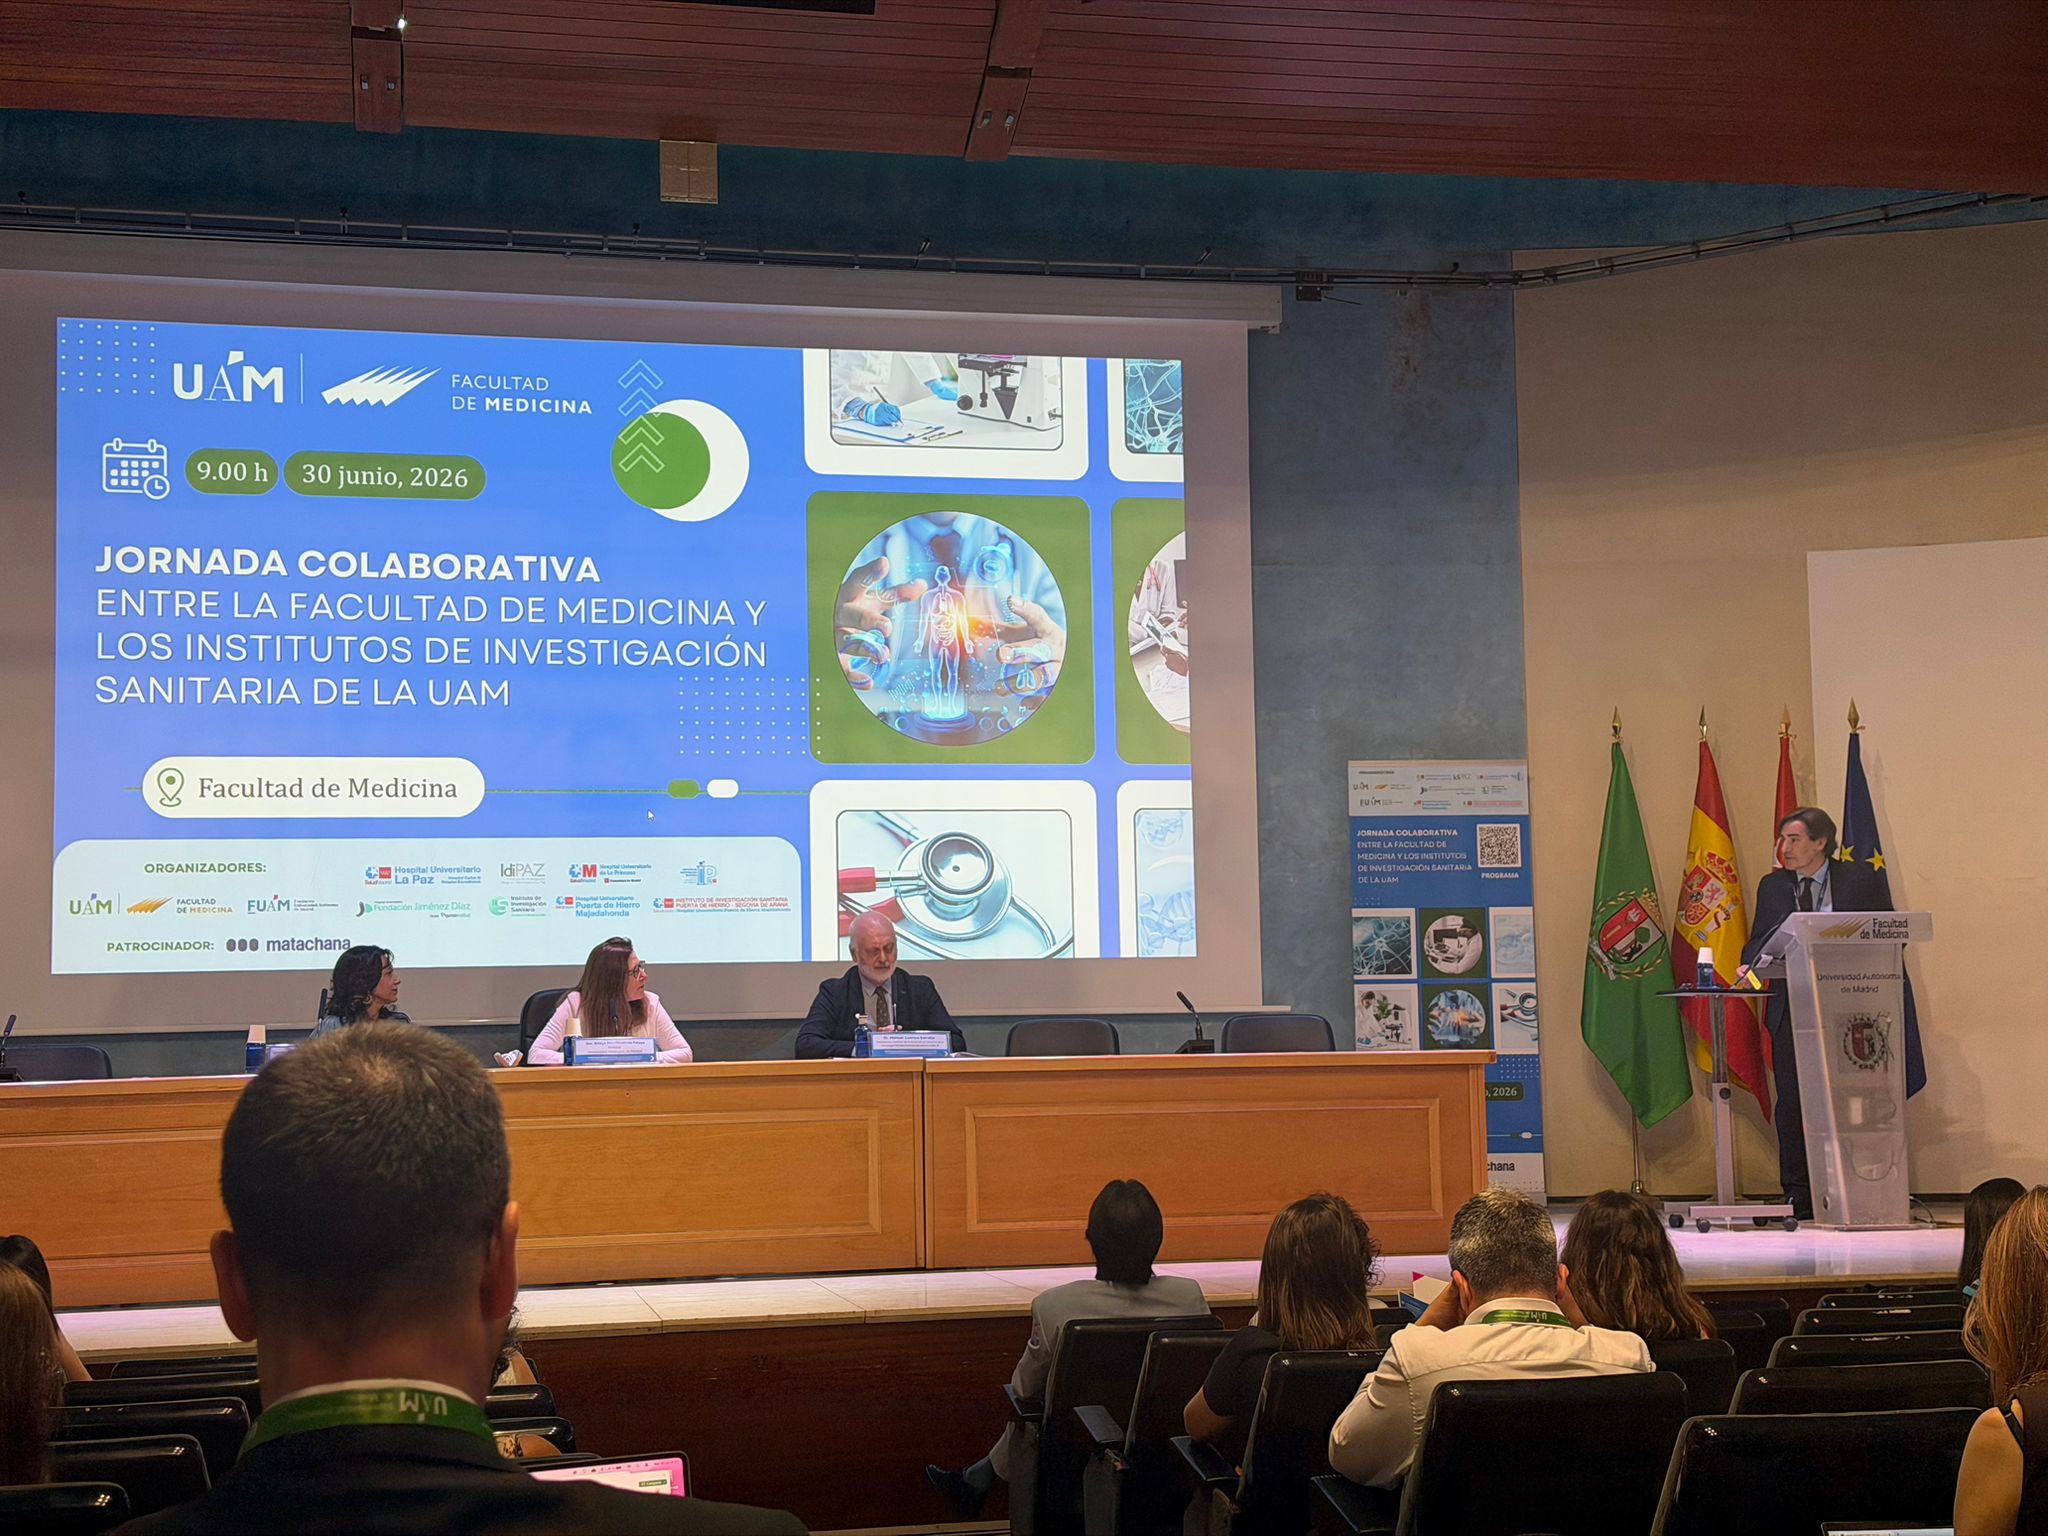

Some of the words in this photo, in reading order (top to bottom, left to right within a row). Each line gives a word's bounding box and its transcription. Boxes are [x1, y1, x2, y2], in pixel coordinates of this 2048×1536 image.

[451, 373, 549, 392] FACULTAD
[451, 395, 477, 412] DE
[484, 397, 593, 415] MEDICINA
[196, 460, 247, 483] 9.00
[253, 462, 269, 483] h
[301, 464, 332, 485] 30
[337, 465, 403, 490] junio,
[409, 467, 468, 488] 2026
[95, 545, 288, 577] JORNADA
[298, 550, 601, 583] COLABORATIVA
[96, 588, 221, 619] ENTRE
[233, 591, 278, 620] LA
[291, 592, 488, 623] FACULTAD
[499, 596, 546, 624] DE
[558, 597, 735, 627] MEDICINA
[744, 600, 767, 627] Y
[96, 632, 173, 661] LOS
[185, 633, 414, 665] INSTITUTOS
[425, 637, 471, 664] DE
[484, 633, 767, 668] INVESTIGACIÓN
[95, 675, 302, 706] SANITARIA
[313, 678, 360, 705] DE
[373, 679, 417, 706] LA
[427, 680, 510, 706] UAM
[198, 775, 304, 801] Facultad
[312, 776, 341, 801] de
[348, 776, 458, 801] Medicina
[1356, 829, 1395, 837] JORNADA
[1396, 829, 1458, 837] COLABORATIVA
[1357, 841, 1382, 849] ENTRE
[1383, 841, 1393, 849] LA
[1394, 841, 1435, 849] FACULTAD
[1420, 852, 1467, 860] INSTITUTOS
[144, 862, 267, 874] ORGANIZADORES:
[394, 866, 428, 875] Hospital
[430, 865, 481, 874] Universitario
[1369, 863, 1431, 872] INVESTIGACIÓN
[394, 875, 409, 885] La
[412, 874, 434, 885] Paz
[1358, 876, 1369, 884] DE
[1369, 876, 1380, 884] LA
[176, 897, 217, 906] FACULTAD
[374, 902, 413, 911] Fundación
[414, 902, 450, 911] Jiménez
[451, 901, 471, 911] Díaz
[603, 901, 614, 909] de
[616, 901, 641, 909] Hierro
[176, 906, 188, 914] DE
[189, 905, 234, 914] MEDICINA
[575, 909, 630, 919] Majadahonda
[1872, 918, 1908, 929] Facultad
[1860, 930, 1870, 940] de
[1872, 929, 1909, 940] Medicina
[107, 940, 215, 952] PATROCINADOR:
[266, 937, 351, 952] matachana
[1817, 973, 1862, 982] Universidad
[1853, 985, 1879, 993] Madrid
[1493, 1087, 1518, 1097] 2026
